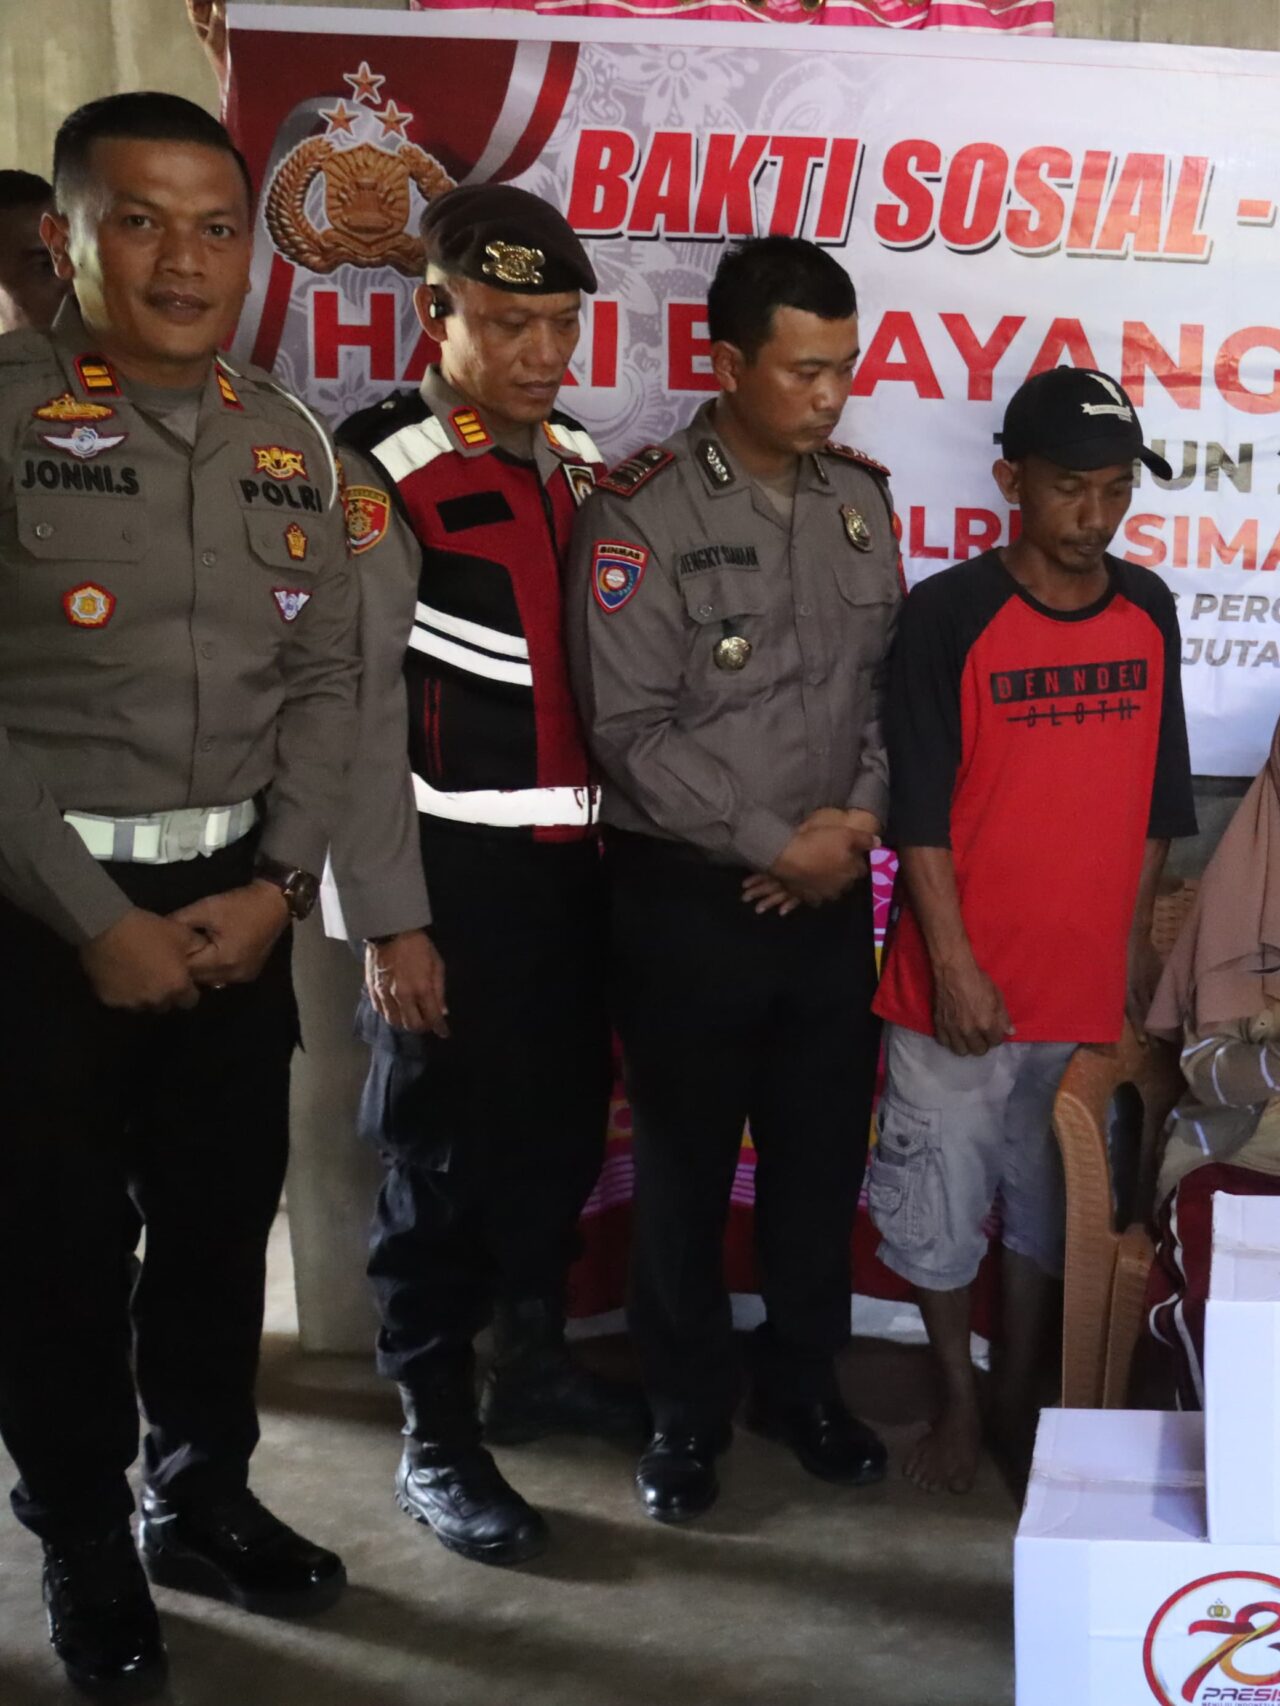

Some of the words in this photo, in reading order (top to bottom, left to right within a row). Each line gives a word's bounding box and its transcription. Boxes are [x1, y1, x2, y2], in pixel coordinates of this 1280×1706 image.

[567, 129, 862, 243] BAKTI
[873, 139, 1213, 261] SOSIAL
[314, 291, 618, 388] HI
[20, 459, 140, 496] JONNI.S
[240, 479, 323, 513] POLRI
[997, 663, 1142, 699] DENNDEV
